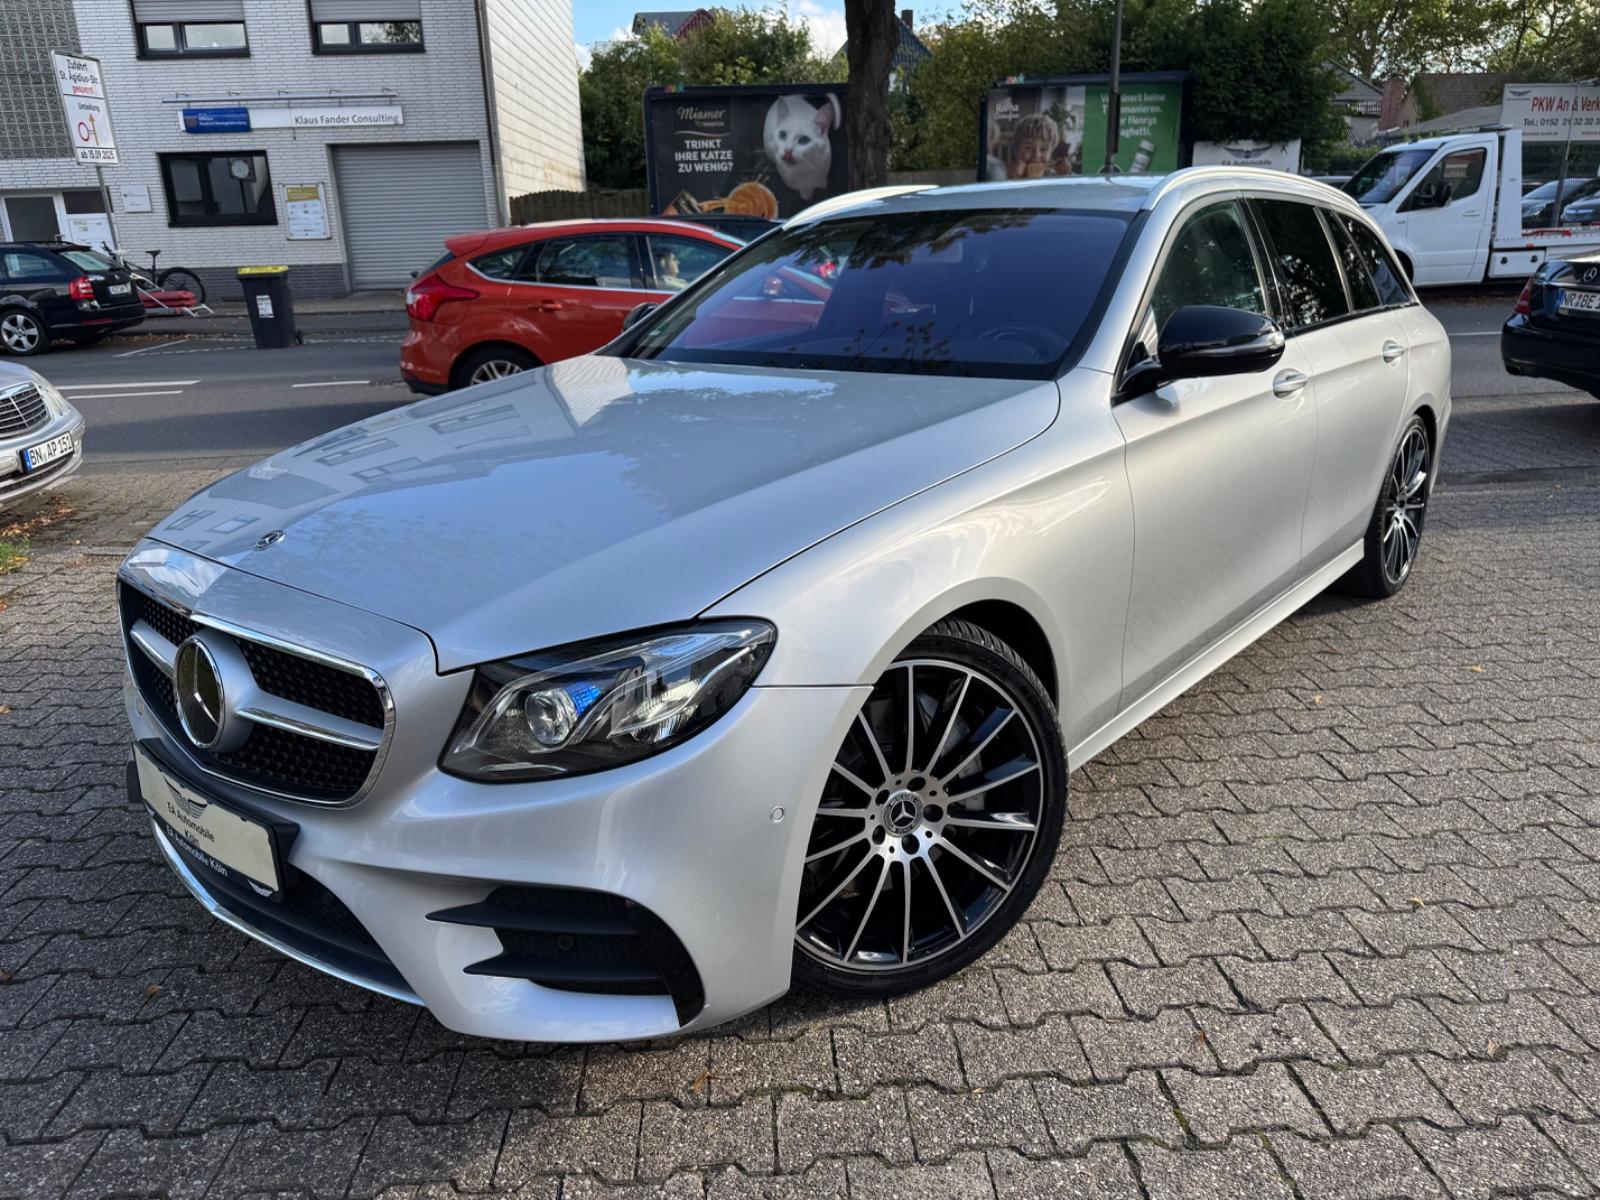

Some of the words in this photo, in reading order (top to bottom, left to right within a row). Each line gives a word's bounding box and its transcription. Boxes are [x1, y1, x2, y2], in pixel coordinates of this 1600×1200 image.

[66, 59, 88, 71] Zufahrt
[59, 70, 67, 81] St.
[72, 85, 94, 95] gesperrt
[1143, 92, 1165, 102] keine
[77, 102, 101, 113] Umleitung
[1530, 96, 1555, 112] PKW
[1555, 96, 1570, 112] An
[294, 115, 319, 125] Klaus
[320, 114, 350, 124] Fander
[351, 113, 400, 124] Consulting
[677, 107, 726, 120] Miamor
[1127, 116, 1157, 127] Henrys
[1523, 117, 1539, 127] Tel.:
[1540, 117, 1559, 127] 0152
[684, 140, 722, 150] TRINKT
[80, 150, 88, 159] ab
[674, 151, 699, 161] IHRE
[700, 150, 734, 160] KATZE
[678, 162, 693, 173] ZU
[694, 161, 734, 172] WENIG?
[30, 447, 43, 466] BN
[46, 442, 57, 457] AP
[58, 436, 72, 454] 151
[167, 801, 177, 815] EA
[177, 809, 215, 842] Automobile
[184, 828, 200, 847] Köln
[175, 833, 209, 866] Automobile
[209, 857, 229, 878] Köln
